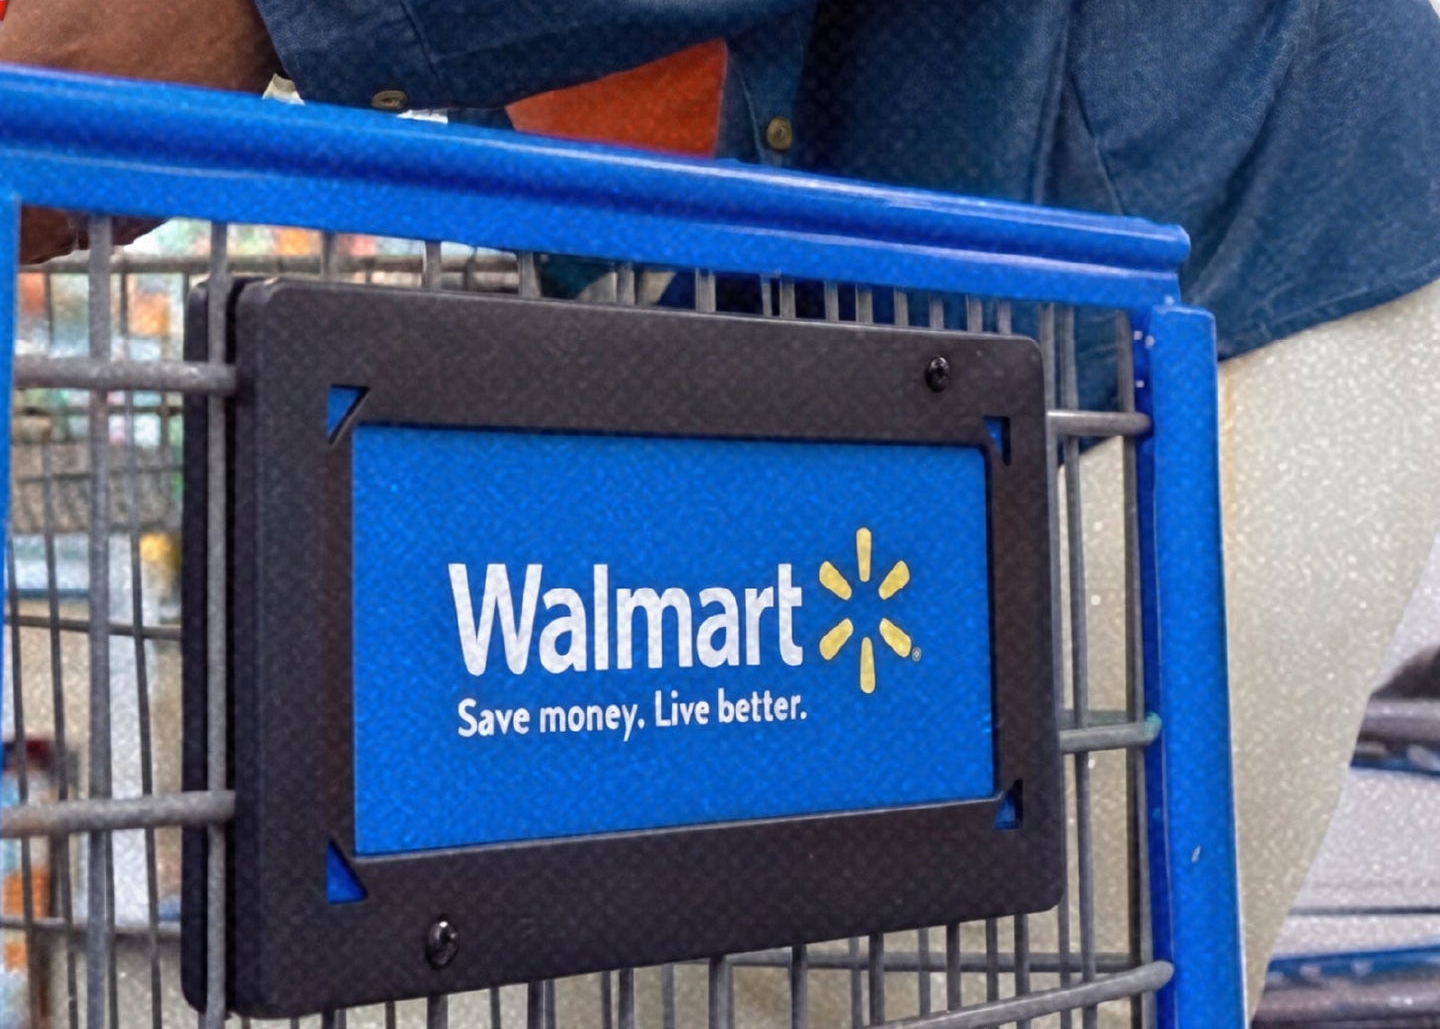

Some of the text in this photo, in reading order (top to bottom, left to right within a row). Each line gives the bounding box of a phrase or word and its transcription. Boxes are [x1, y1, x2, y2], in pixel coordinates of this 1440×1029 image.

[448, 563, 804, 676] Walmart
[457, 688, 807, 742] Save money. Live better.
